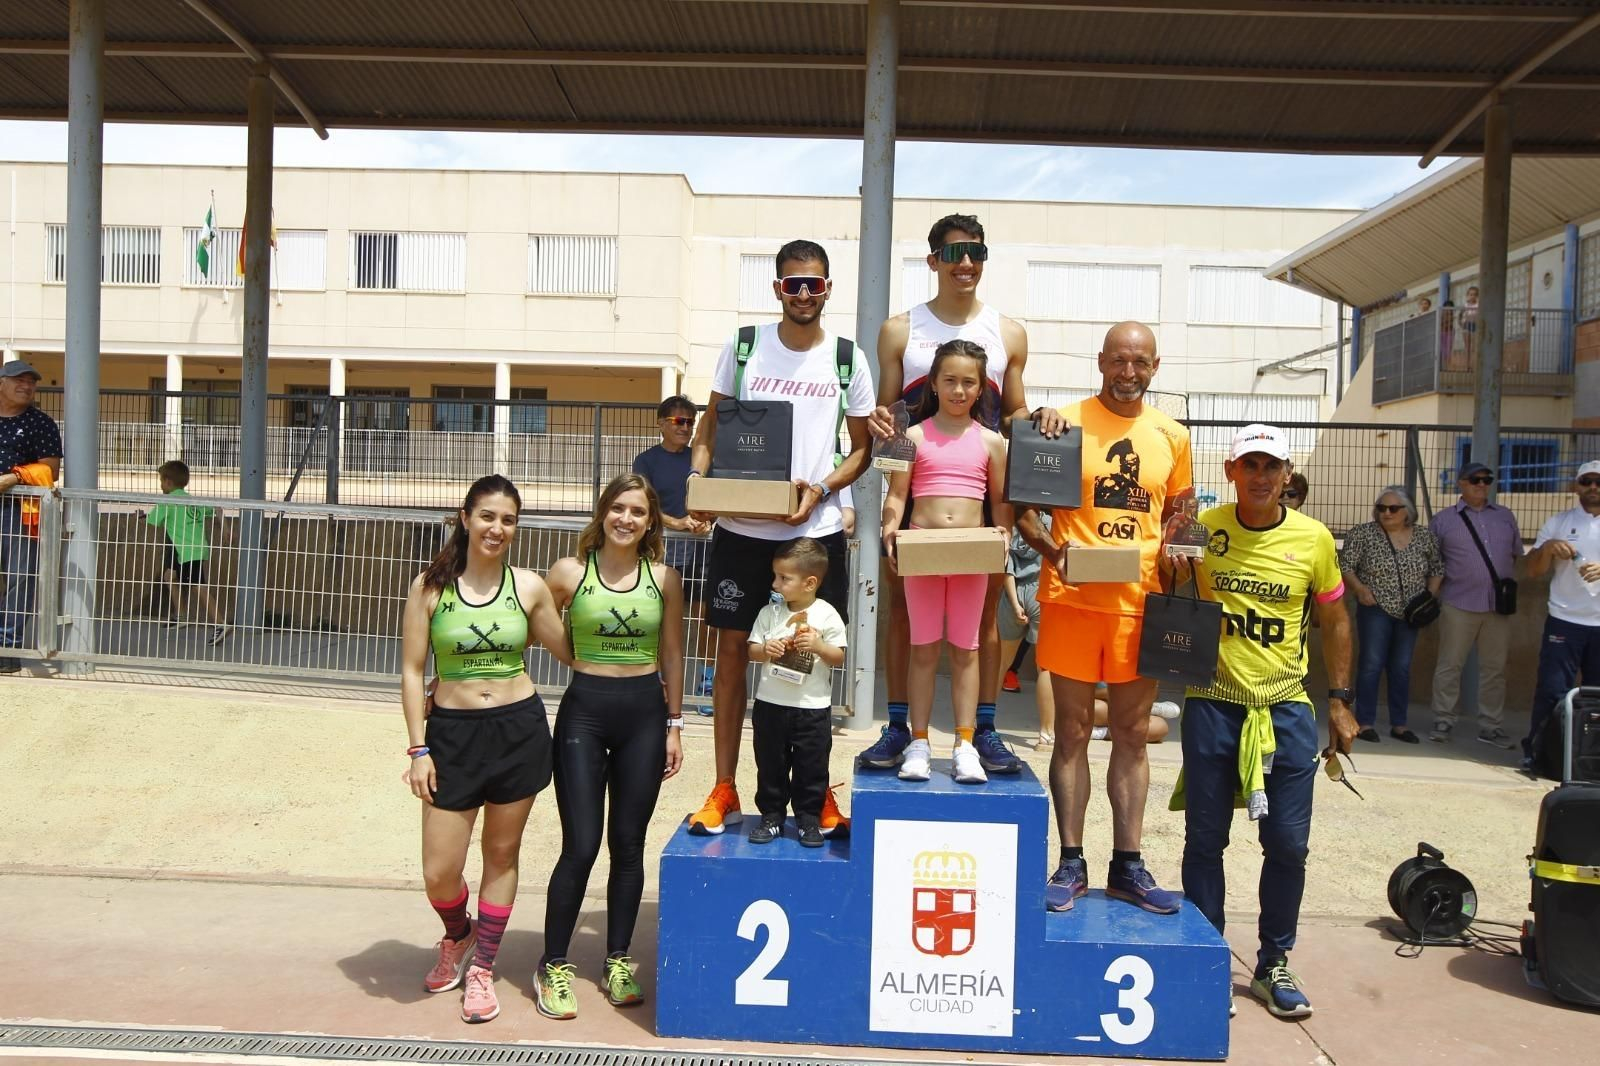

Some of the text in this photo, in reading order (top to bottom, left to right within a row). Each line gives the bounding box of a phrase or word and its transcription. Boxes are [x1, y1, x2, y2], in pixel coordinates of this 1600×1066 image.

[737, 435, 766, 446] AIRE
[1033, 455, 1061, 467] AIRE
[1127, 487, 1147, 498] XIII
[1097, 521, 1136, 541] CASI
[1215, 576, 1290, 598] SPORTGYM
[1163, 633, 1192, 646] AIRE
[735, 899, 790, 1007] 2
[879, 969, 1005, 998] ALMERÍA
[909, 998, 974, 1014] CIUDAD
[1100, 954, 1155, 1045] 3
